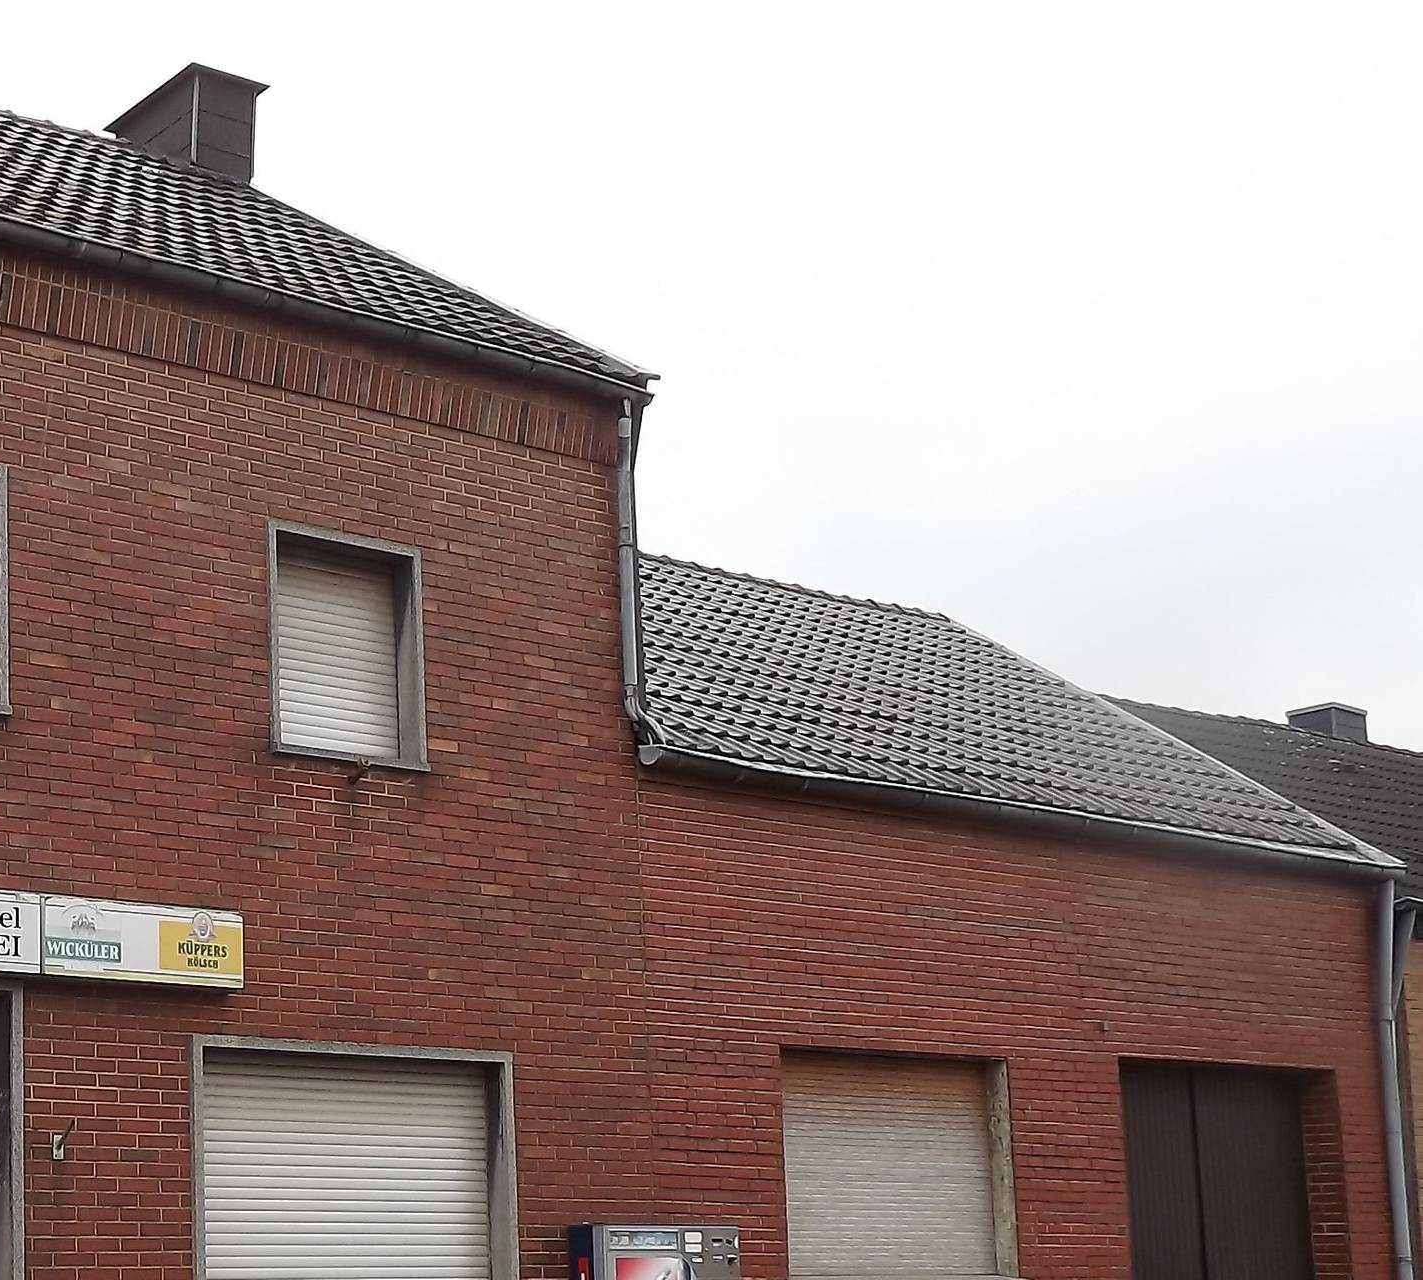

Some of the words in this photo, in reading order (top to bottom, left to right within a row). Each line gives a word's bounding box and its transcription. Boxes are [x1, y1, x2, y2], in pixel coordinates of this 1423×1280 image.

[45, 939, 120, 960] WICKÜLER
[177, 939, 228, 958] KÜPPERS
[187, 957, 219, 969] KÖLSCH
